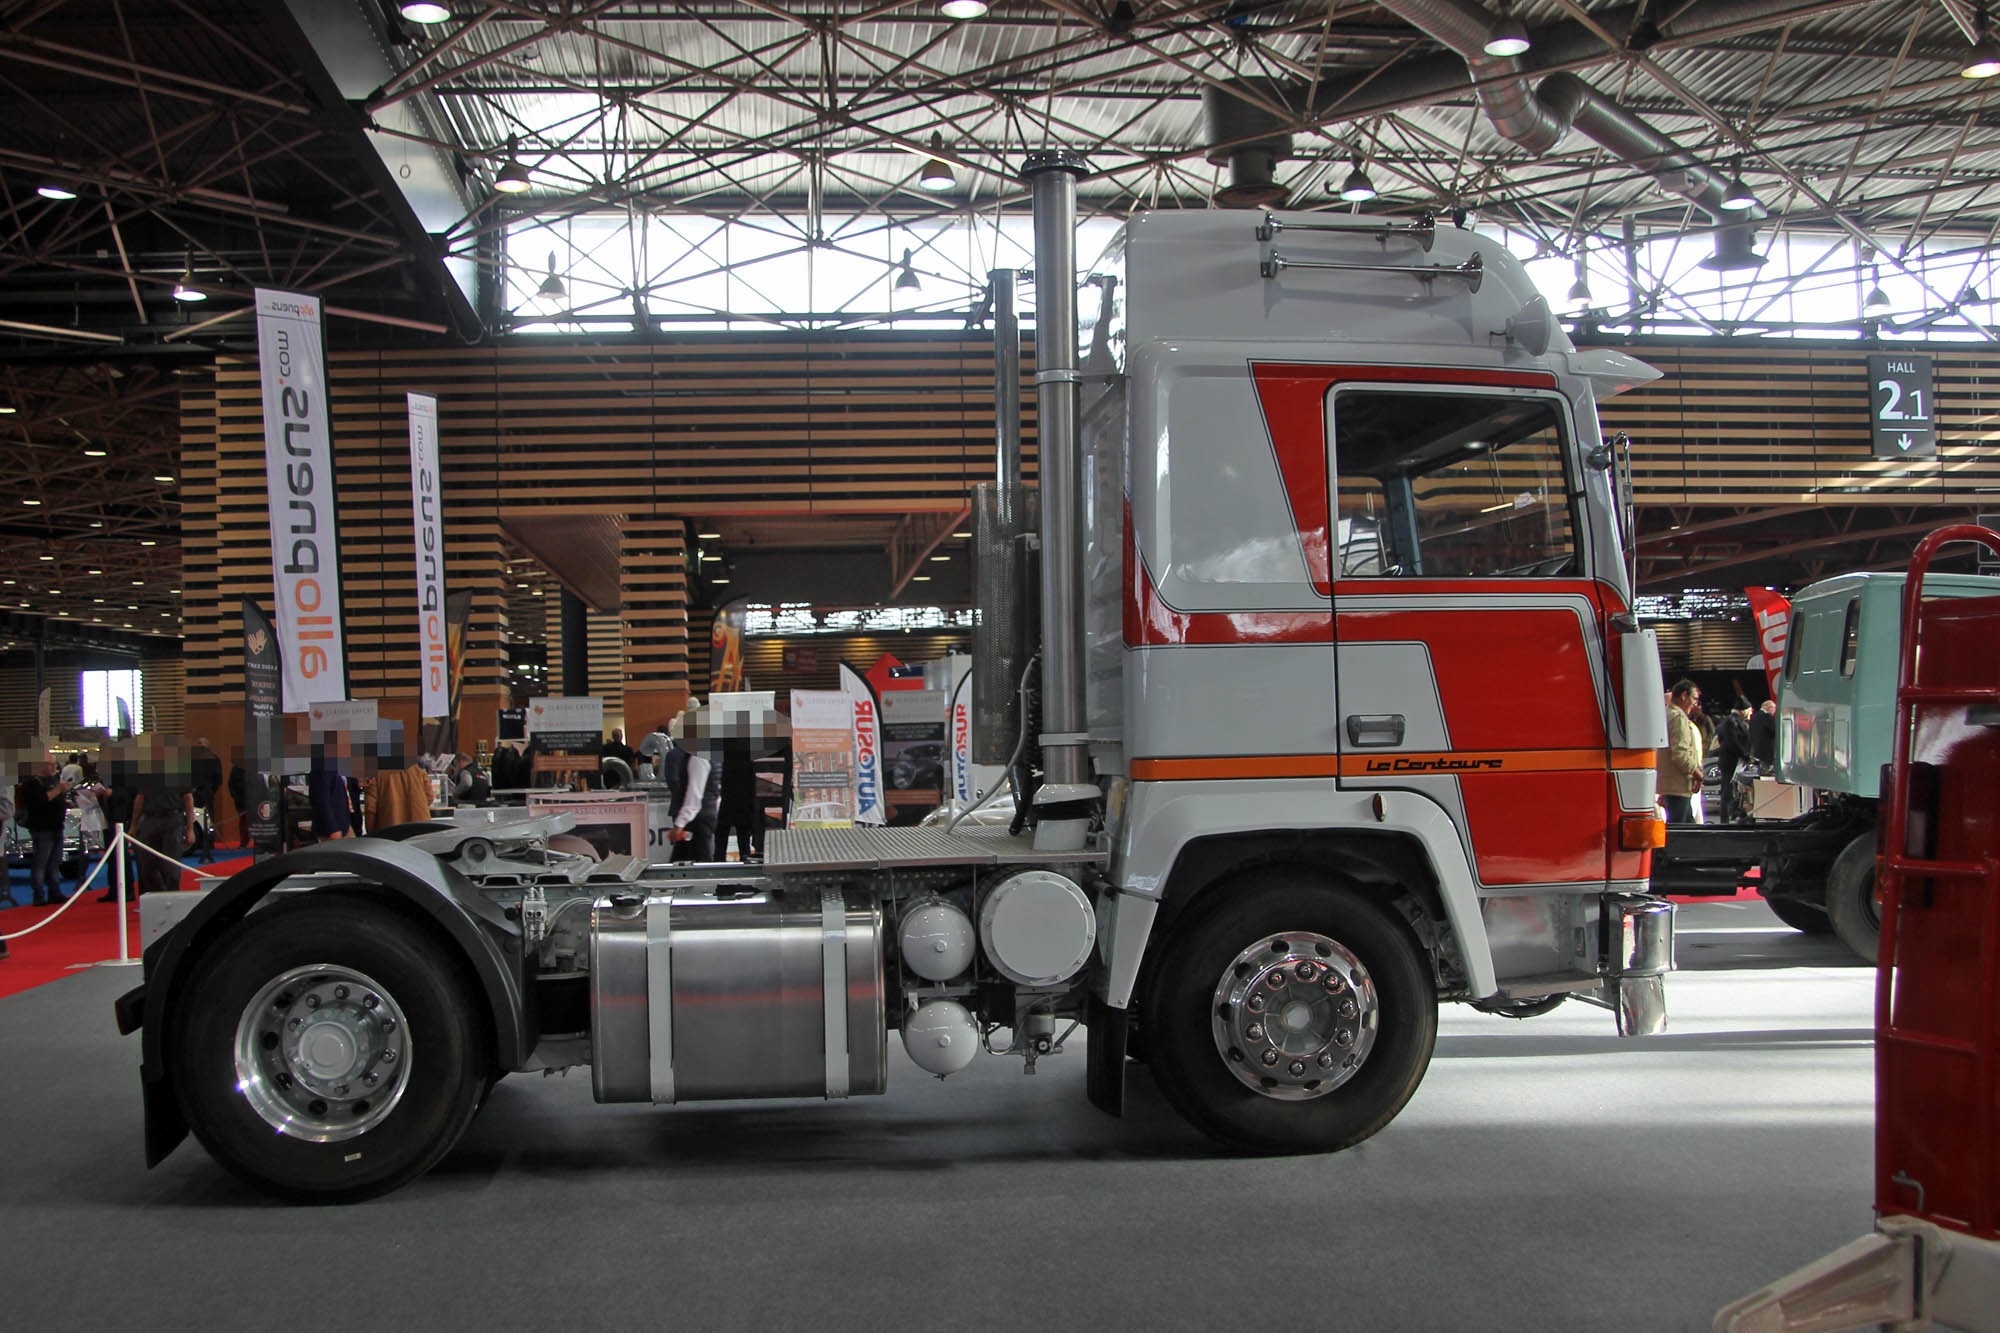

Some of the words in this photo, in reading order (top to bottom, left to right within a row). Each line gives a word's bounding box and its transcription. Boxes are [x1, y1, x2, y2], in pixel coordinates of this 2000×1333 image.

[1887, 362, 1916, 373] HALL
[1878, 379, 1929, 420] 2.1
[955, 703, 969, 802] AUTOSUR
[1366, 759, 1391, 771] Le
[1393, 757, 1503, 771] Centaure
